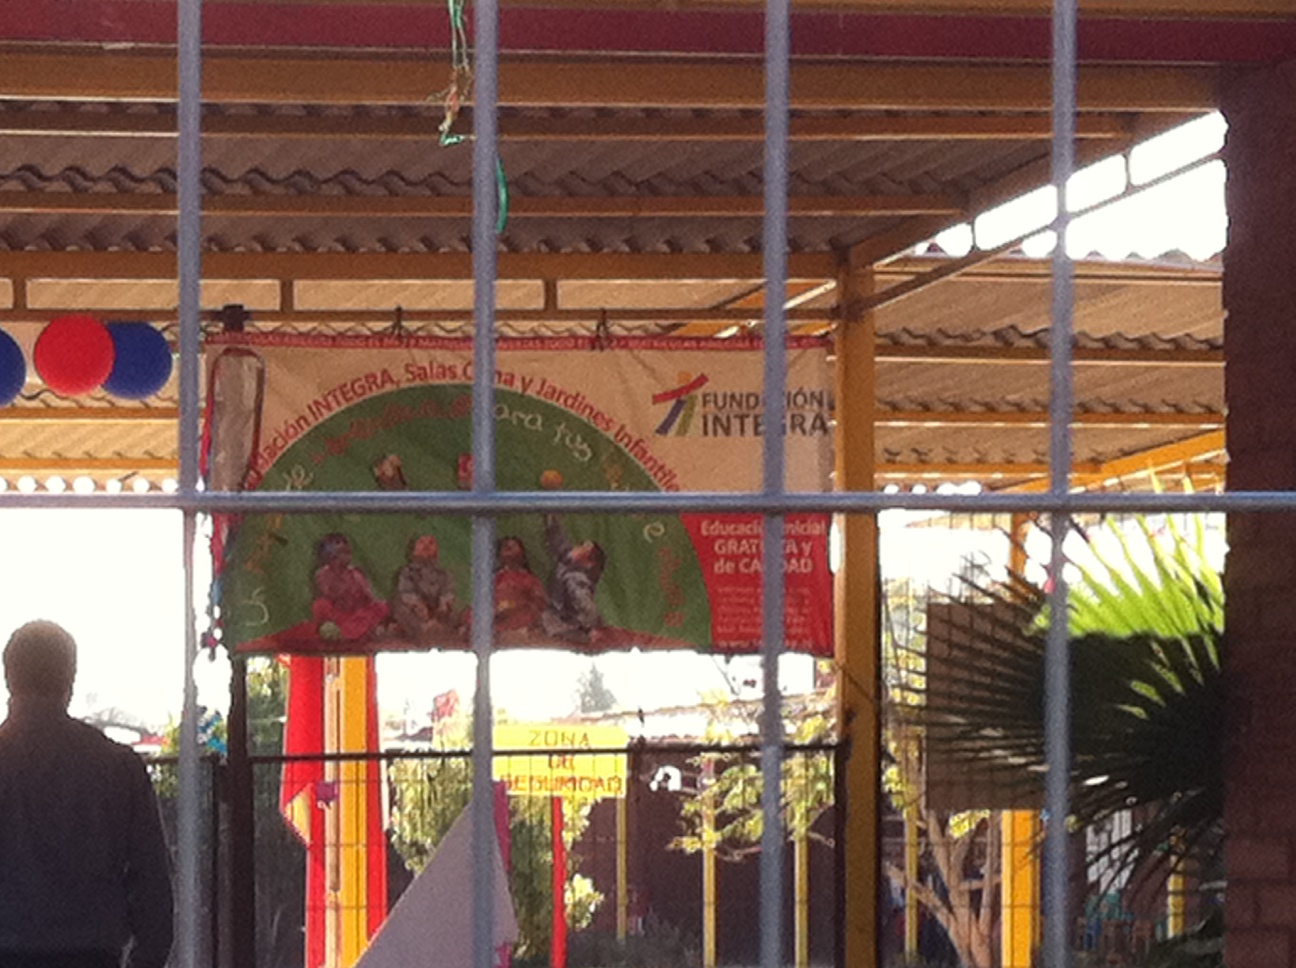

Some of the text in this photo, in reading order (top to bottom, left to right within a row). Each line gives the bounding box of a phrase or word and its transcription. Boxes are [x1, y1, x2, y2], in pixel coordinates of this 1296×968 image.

[404, 361, 457, 384] Salas
[521, 375, 535, 396] y
[533, 377, 614, 432] Jardines
[702, 386, 824, 410] FUNDIÓN
[494, 404, 542, 431] ara
[703, 412, 829, 436] INTERA
[701, 519, 826, 536] Educaci nicial
[714, 539, 812, 557] GRATA y
[714, 558, 813, 574] de CAAD
[529, 729, 592, 748] ZONA
